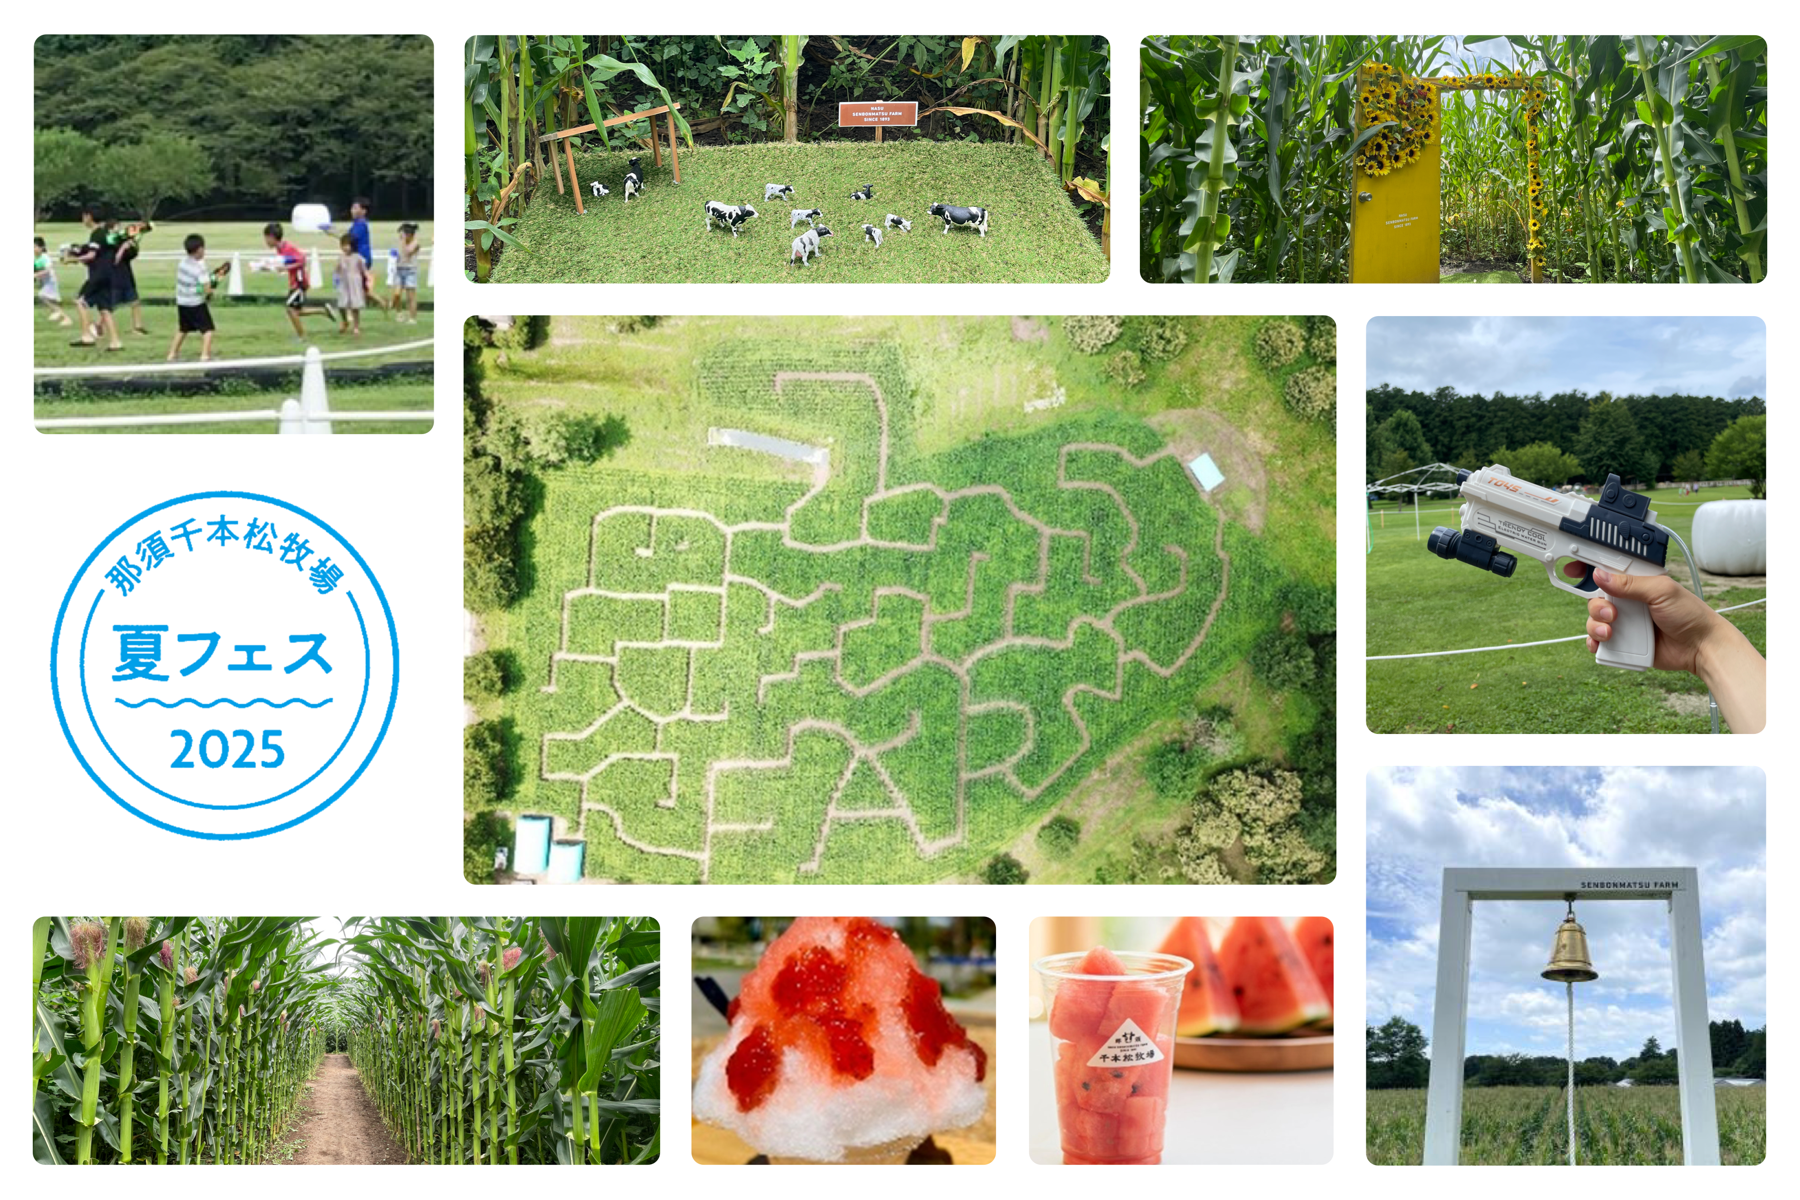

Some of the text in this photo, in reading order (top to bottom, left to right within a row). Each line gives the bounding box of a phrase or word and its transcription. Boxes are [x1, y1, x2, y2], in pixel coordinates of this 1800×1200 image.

[1498, 520, 1547, 542] TRENDY COOL
[1521, 534, 1536, 542] WATER
[1581, 881, 1679, 889] SENBONMATSU FARM
